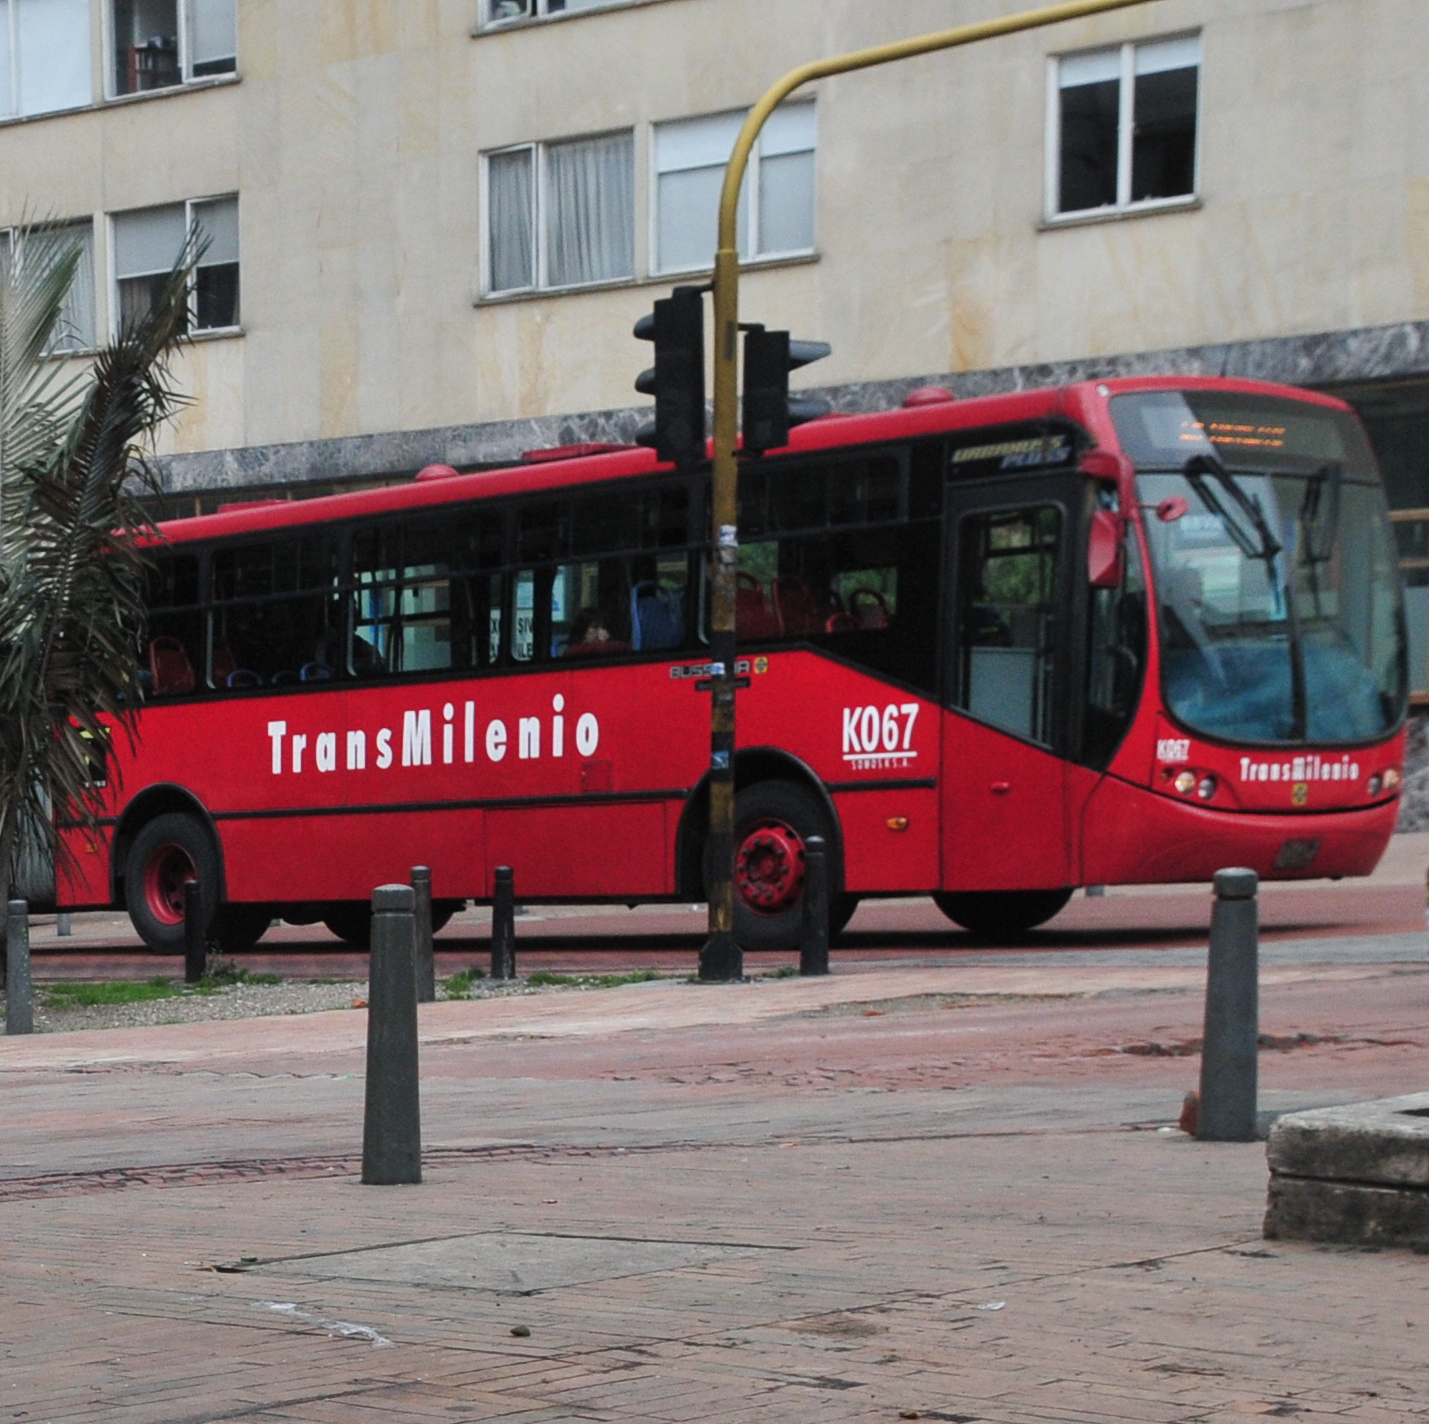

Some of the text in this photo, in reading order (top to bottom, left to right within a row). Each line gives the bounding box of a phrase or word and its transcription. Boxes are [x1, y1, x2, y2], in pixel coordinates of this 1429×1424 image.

[267, 693, 600, 775] TransMilenio
[842, 703, 920, 753] K067
[1240, 755, 1360, 782] TransMilenio
